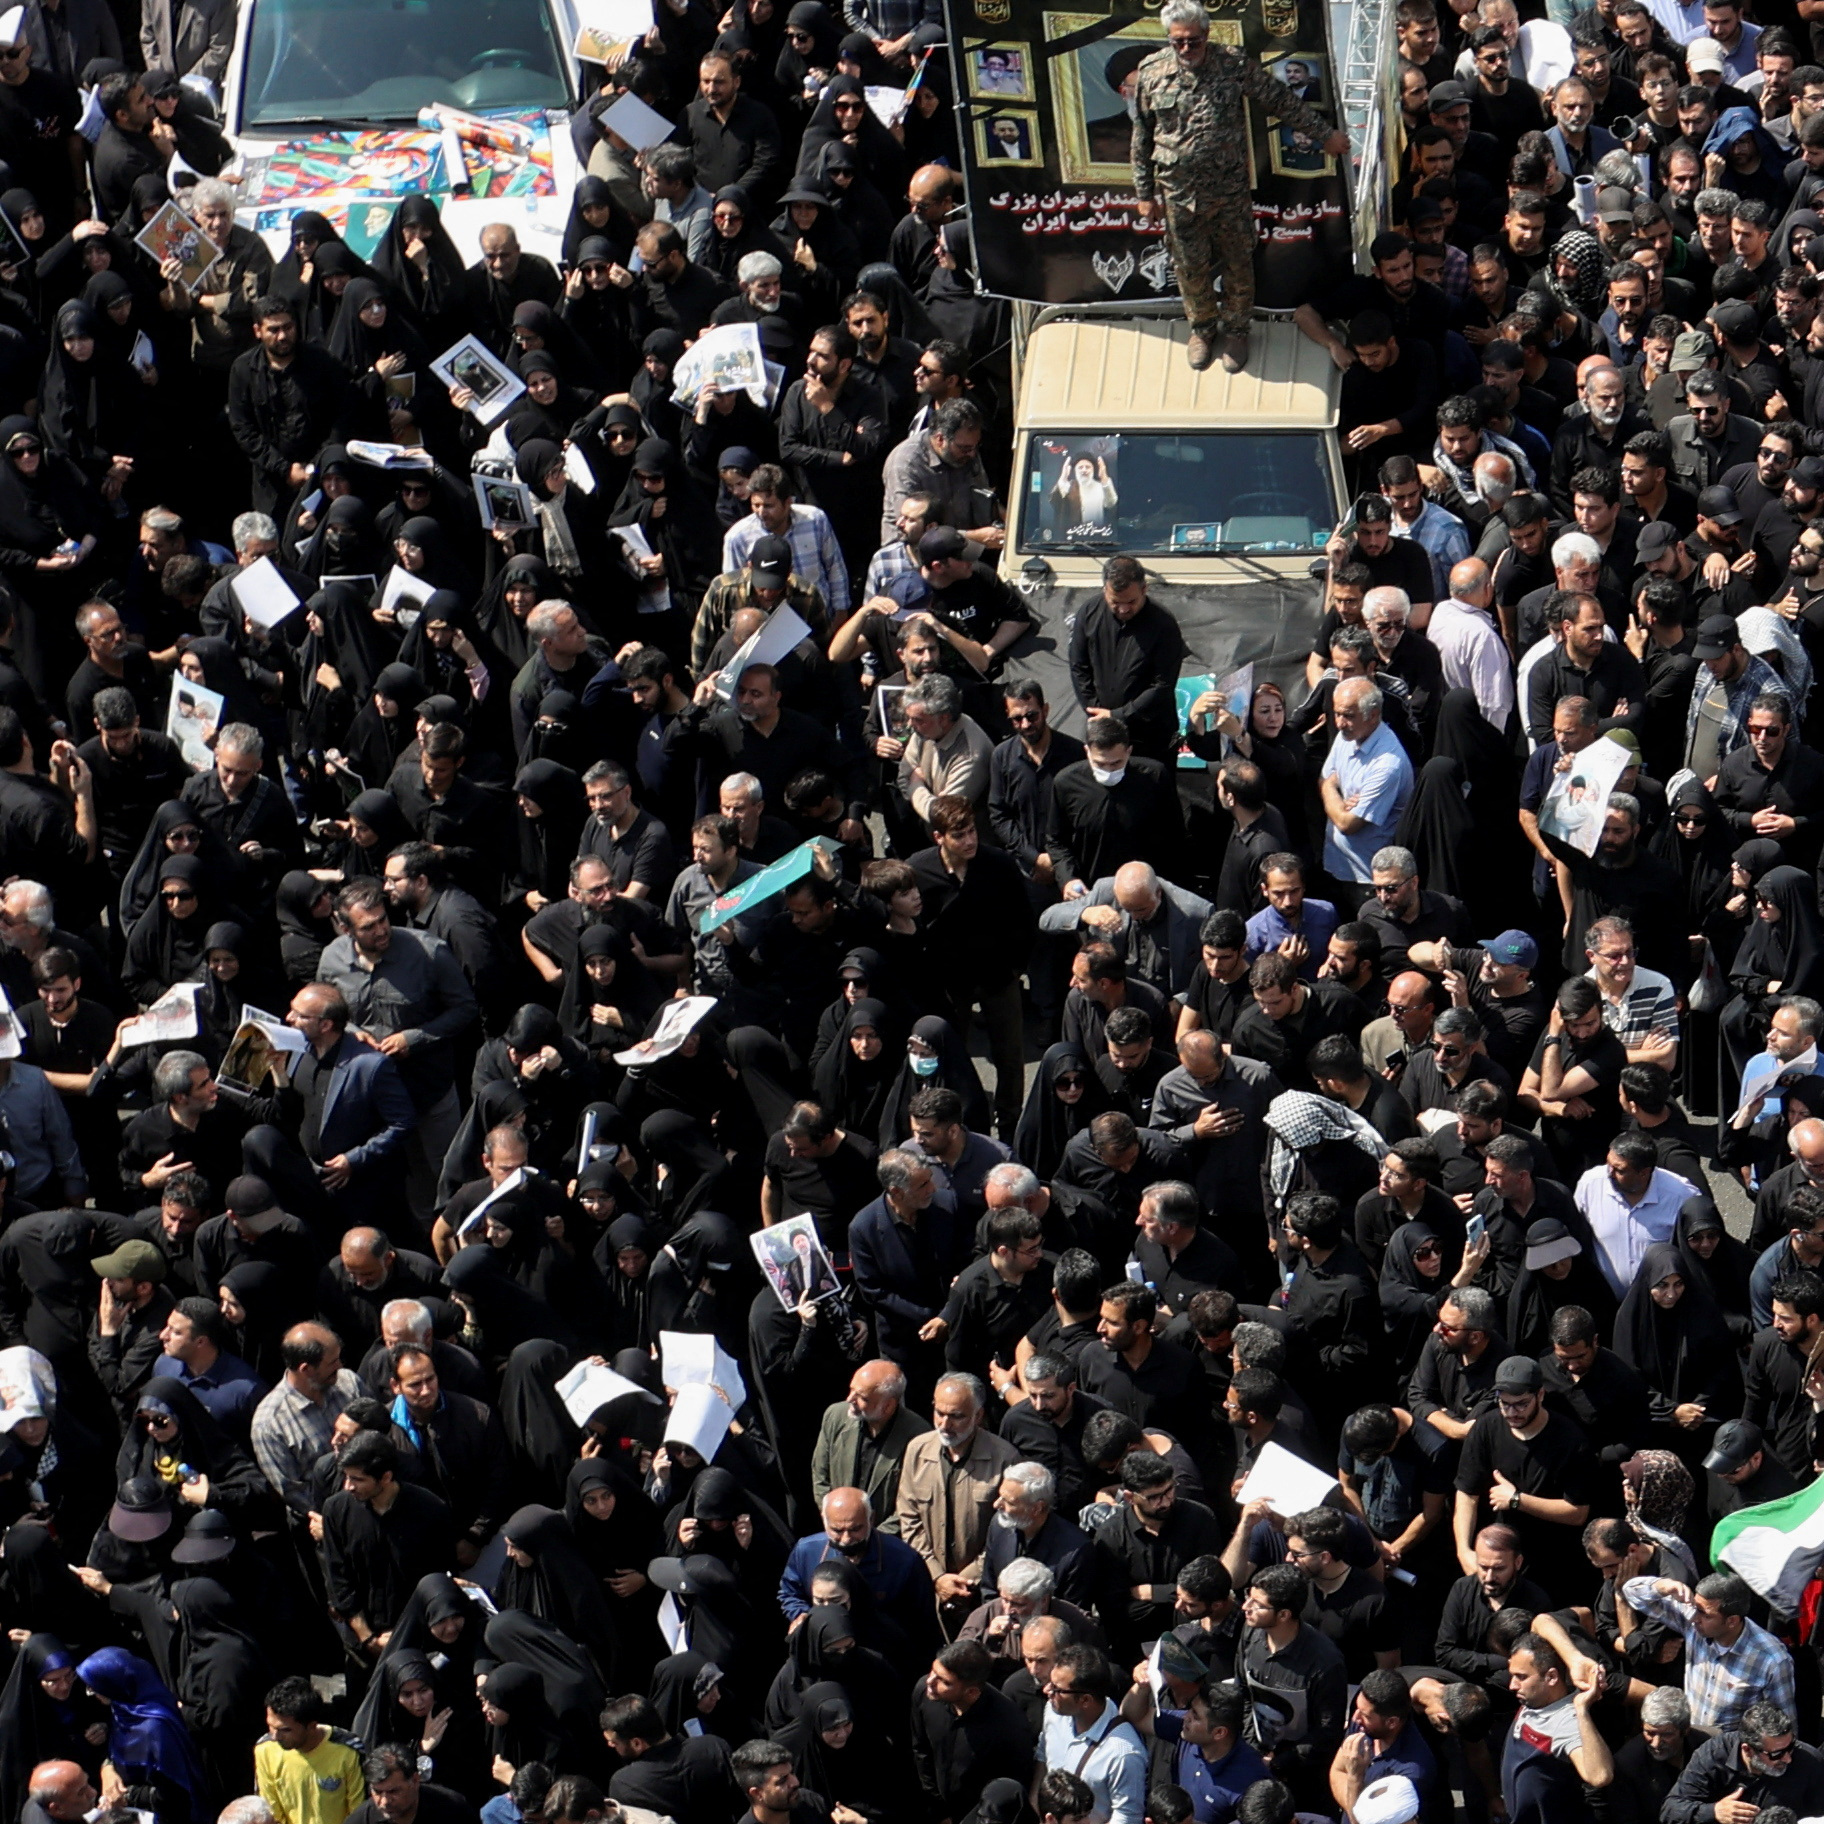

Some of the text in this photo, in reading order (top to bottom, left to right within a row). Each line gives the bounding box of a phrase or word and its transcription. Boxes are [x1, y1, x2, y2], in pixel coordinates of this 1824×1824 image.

[989, 190, 1037, 211] بزرگ
[1040, 190, 1086, 210] تهران
[1252, 200, 1279, 216] بسی
[1282, 200, 1342, 222] سازمان
[1021, 212, 1066, 232] ایران
[1068, 212, 1129, 232] اسلامی
[1272, 221, 1313, 240] بسیج
